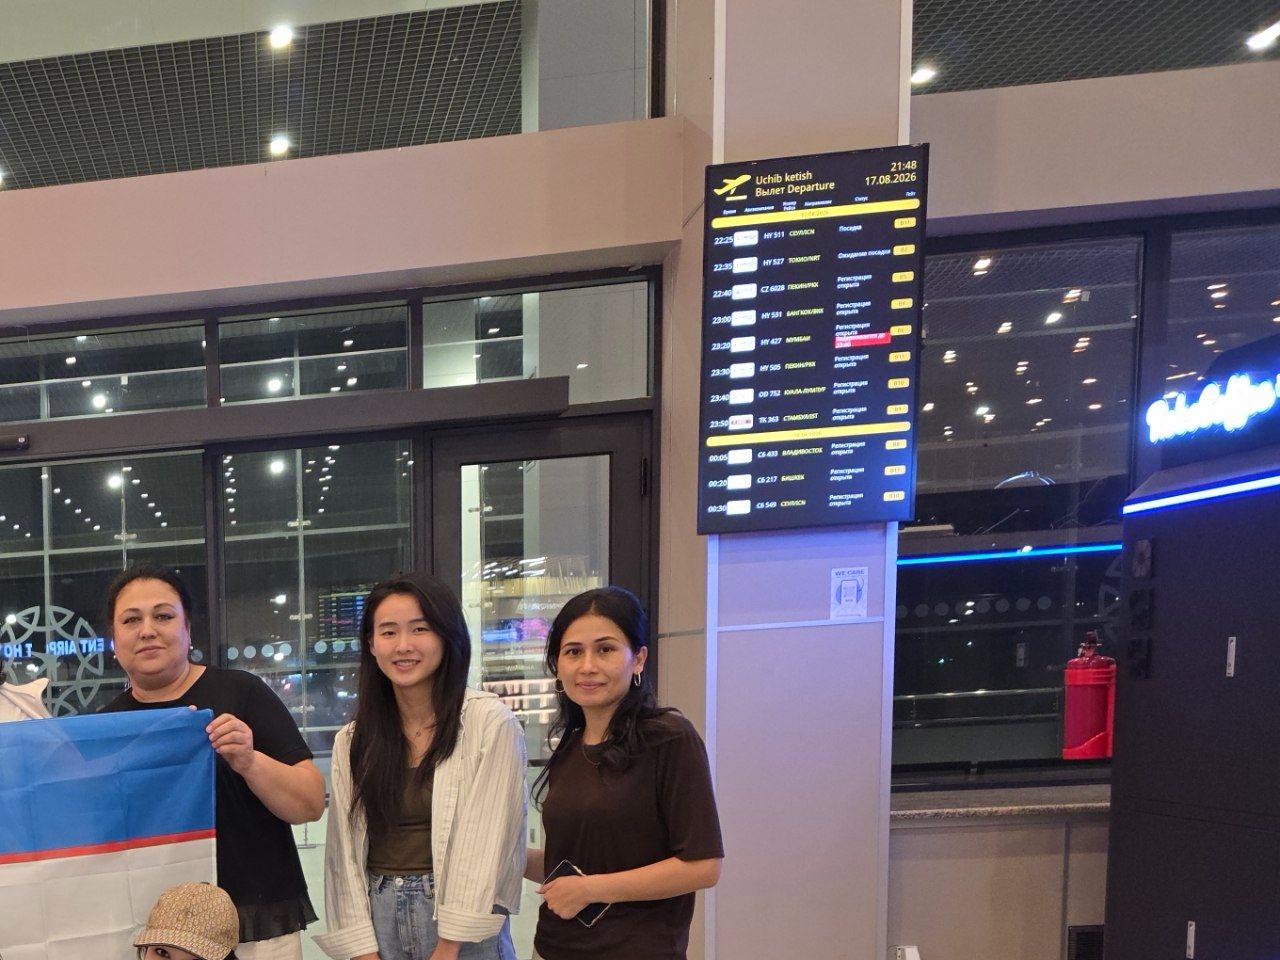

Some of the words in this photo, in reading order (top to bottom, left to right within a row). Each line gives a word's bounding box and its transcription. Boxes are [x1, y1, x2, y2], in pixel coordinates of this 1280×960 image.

[890, 160, 917, 173] 21:48
[756, 171, 783, 186] Uchib
[785, 169, 813, 182] ketish
[865, 172, 917, 186] 17.08.2026
[755, 186, 785, 197] Вылет
[787, 181, 836, 195] Departure
[714, 236, 733, 245] 22:25
[713, 263, 732, 271] 22:35
[713, 289, 732, 298] 22:40
[712, 316, 732, 324] 23:00
[711, 342, 730, 350] 23:20
[711, 368, 730, 377] 23:30
[710, 394, 729, 402] 23:40
[709, 420, 729, 428] 23:50
[708, 454, 728, 462] 00:05
[708, 480, 727, 488] 00:20
[707, 505, 727, 513] 00:30
